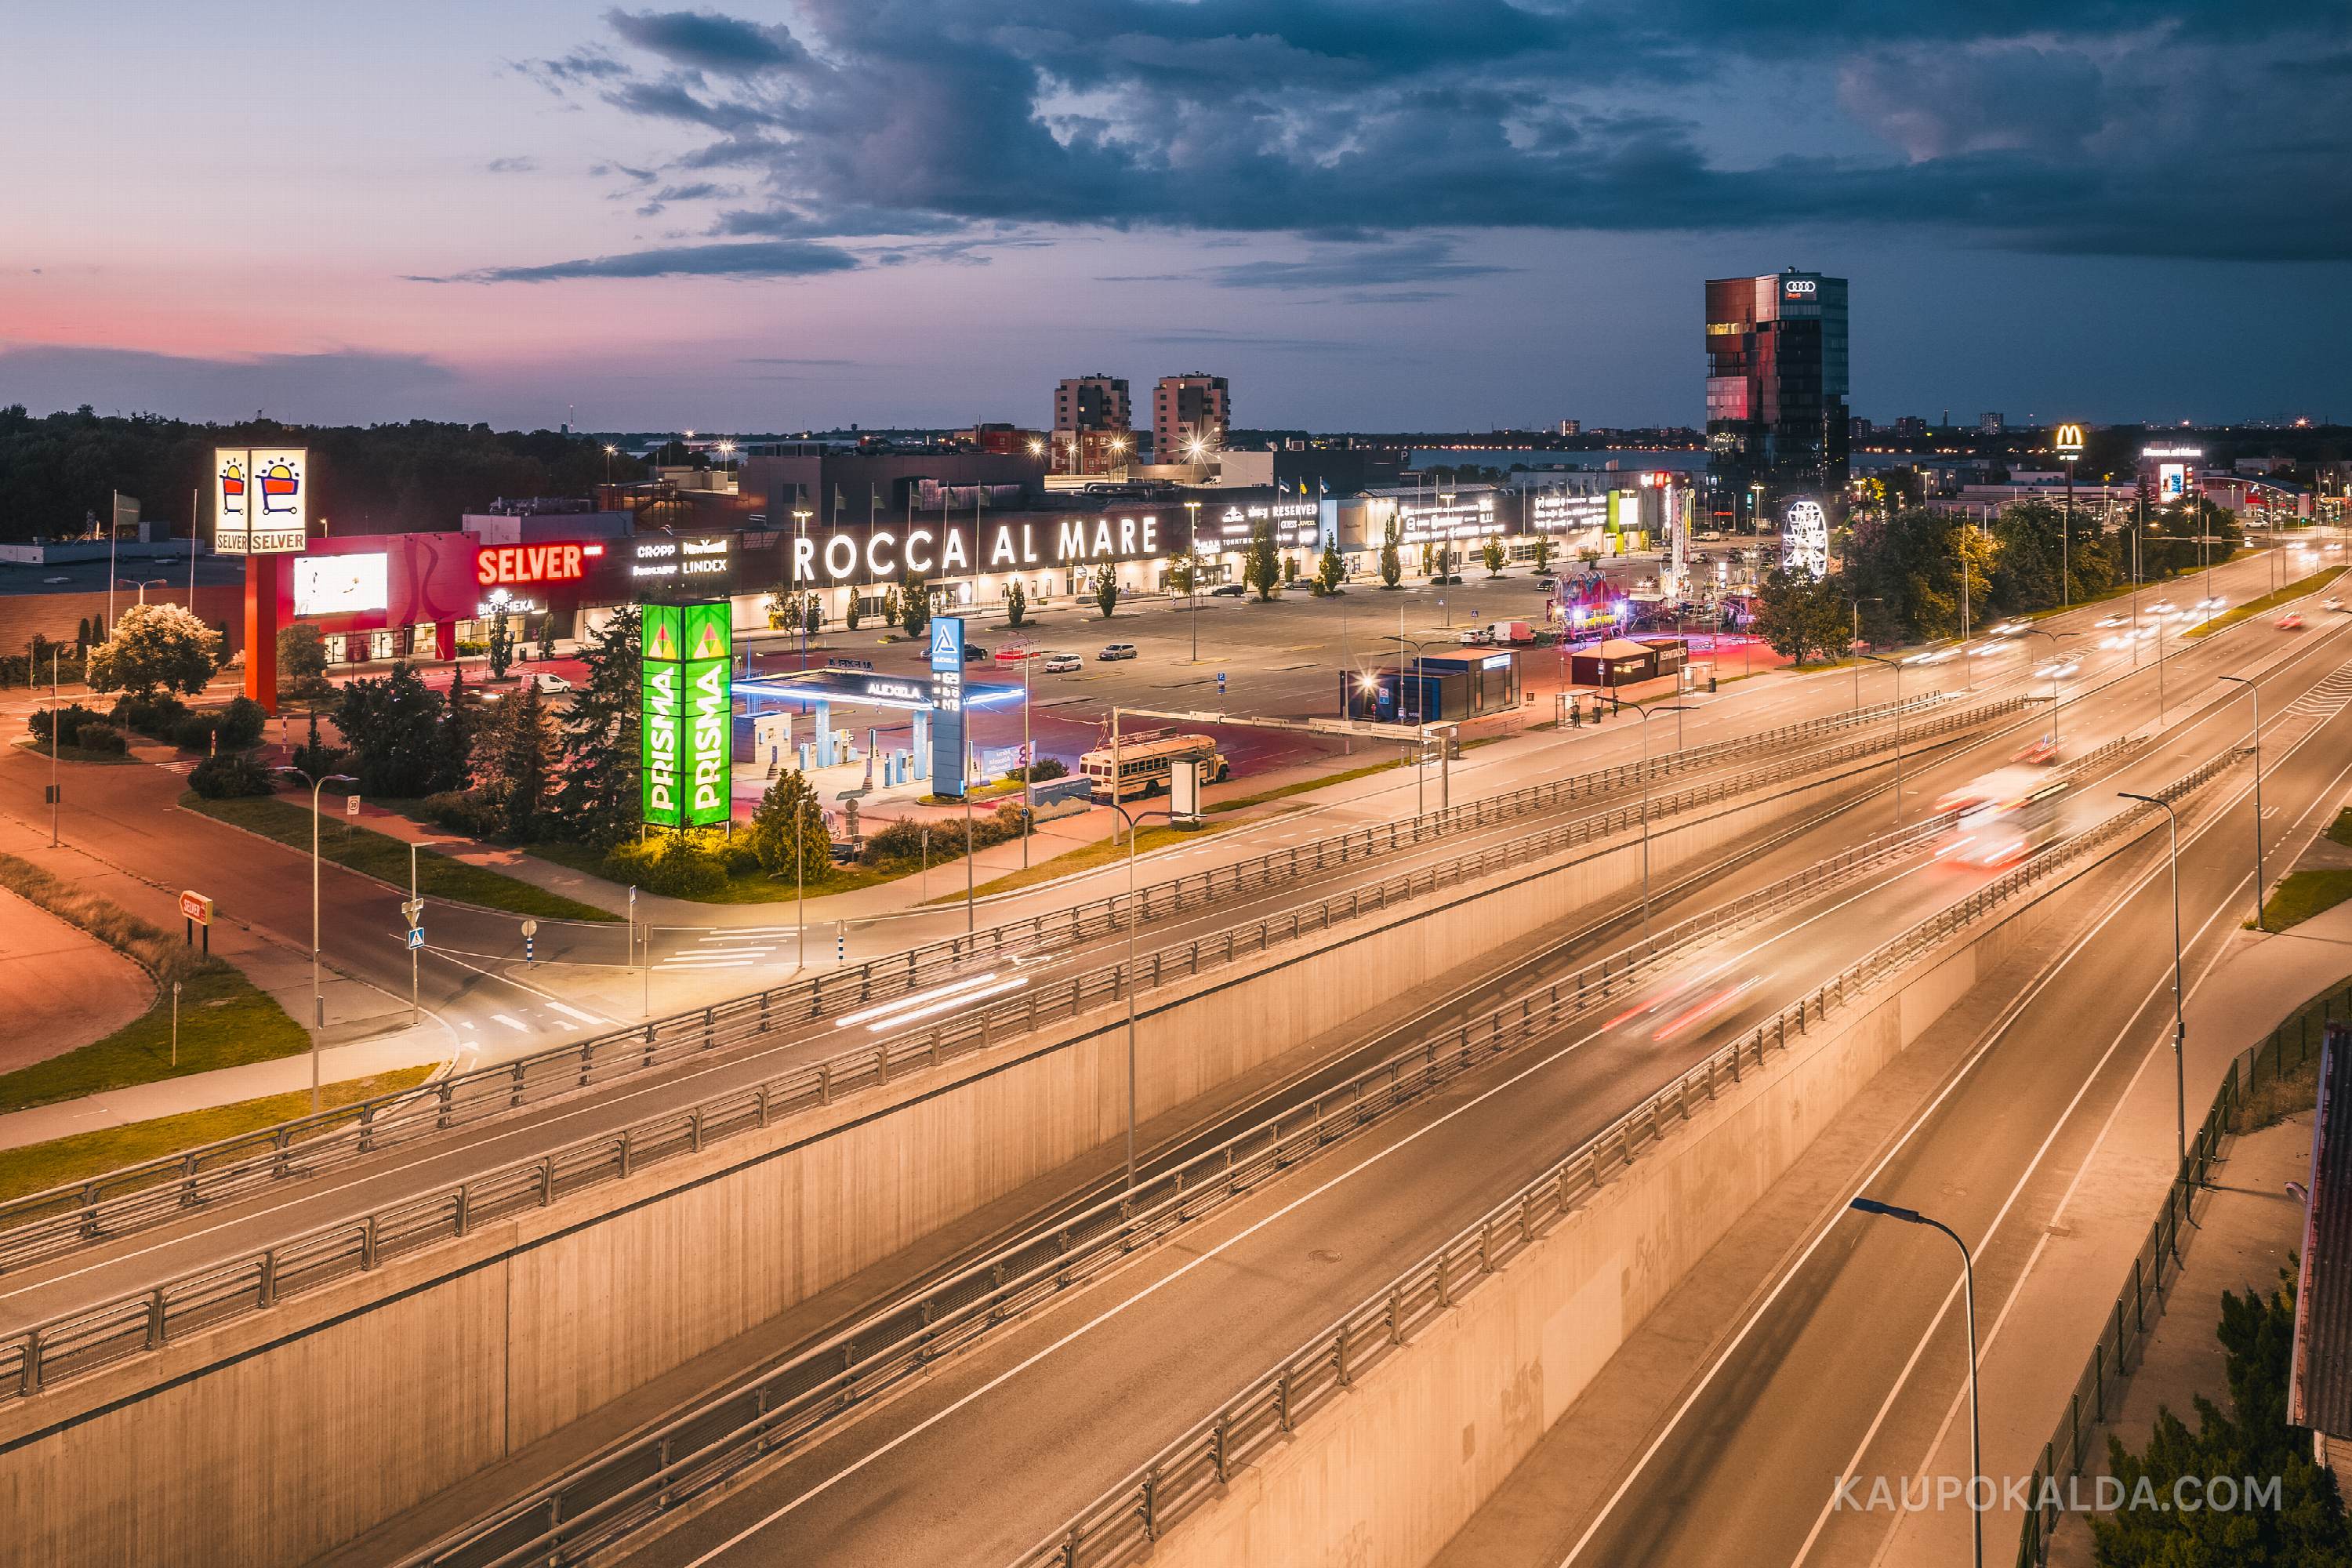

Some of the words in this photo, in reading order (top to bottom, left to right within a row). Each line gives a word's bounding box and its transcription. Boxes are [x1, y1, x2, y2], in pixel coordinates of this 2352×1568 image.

[1272, 504, 1317, 517] RESERVED
[217, 534, 248, 550] SELVER
[252, 534, 304, 550] SELVER
[794, 528, 967, 582] ROCCA
[992, 524, 1037, 565] AL
[1058, 517, 1156, 560] MARE
[637, 545, 676, 558] CROPP
[477, 546, 583, 585] SELVER
[682, 560, 728, 574] LINDEX
[867, 684, 920, 699] ALEXELA
[651, 666, 675, 811] PRISMA
[695, 664, 722, 811] PRISMA
